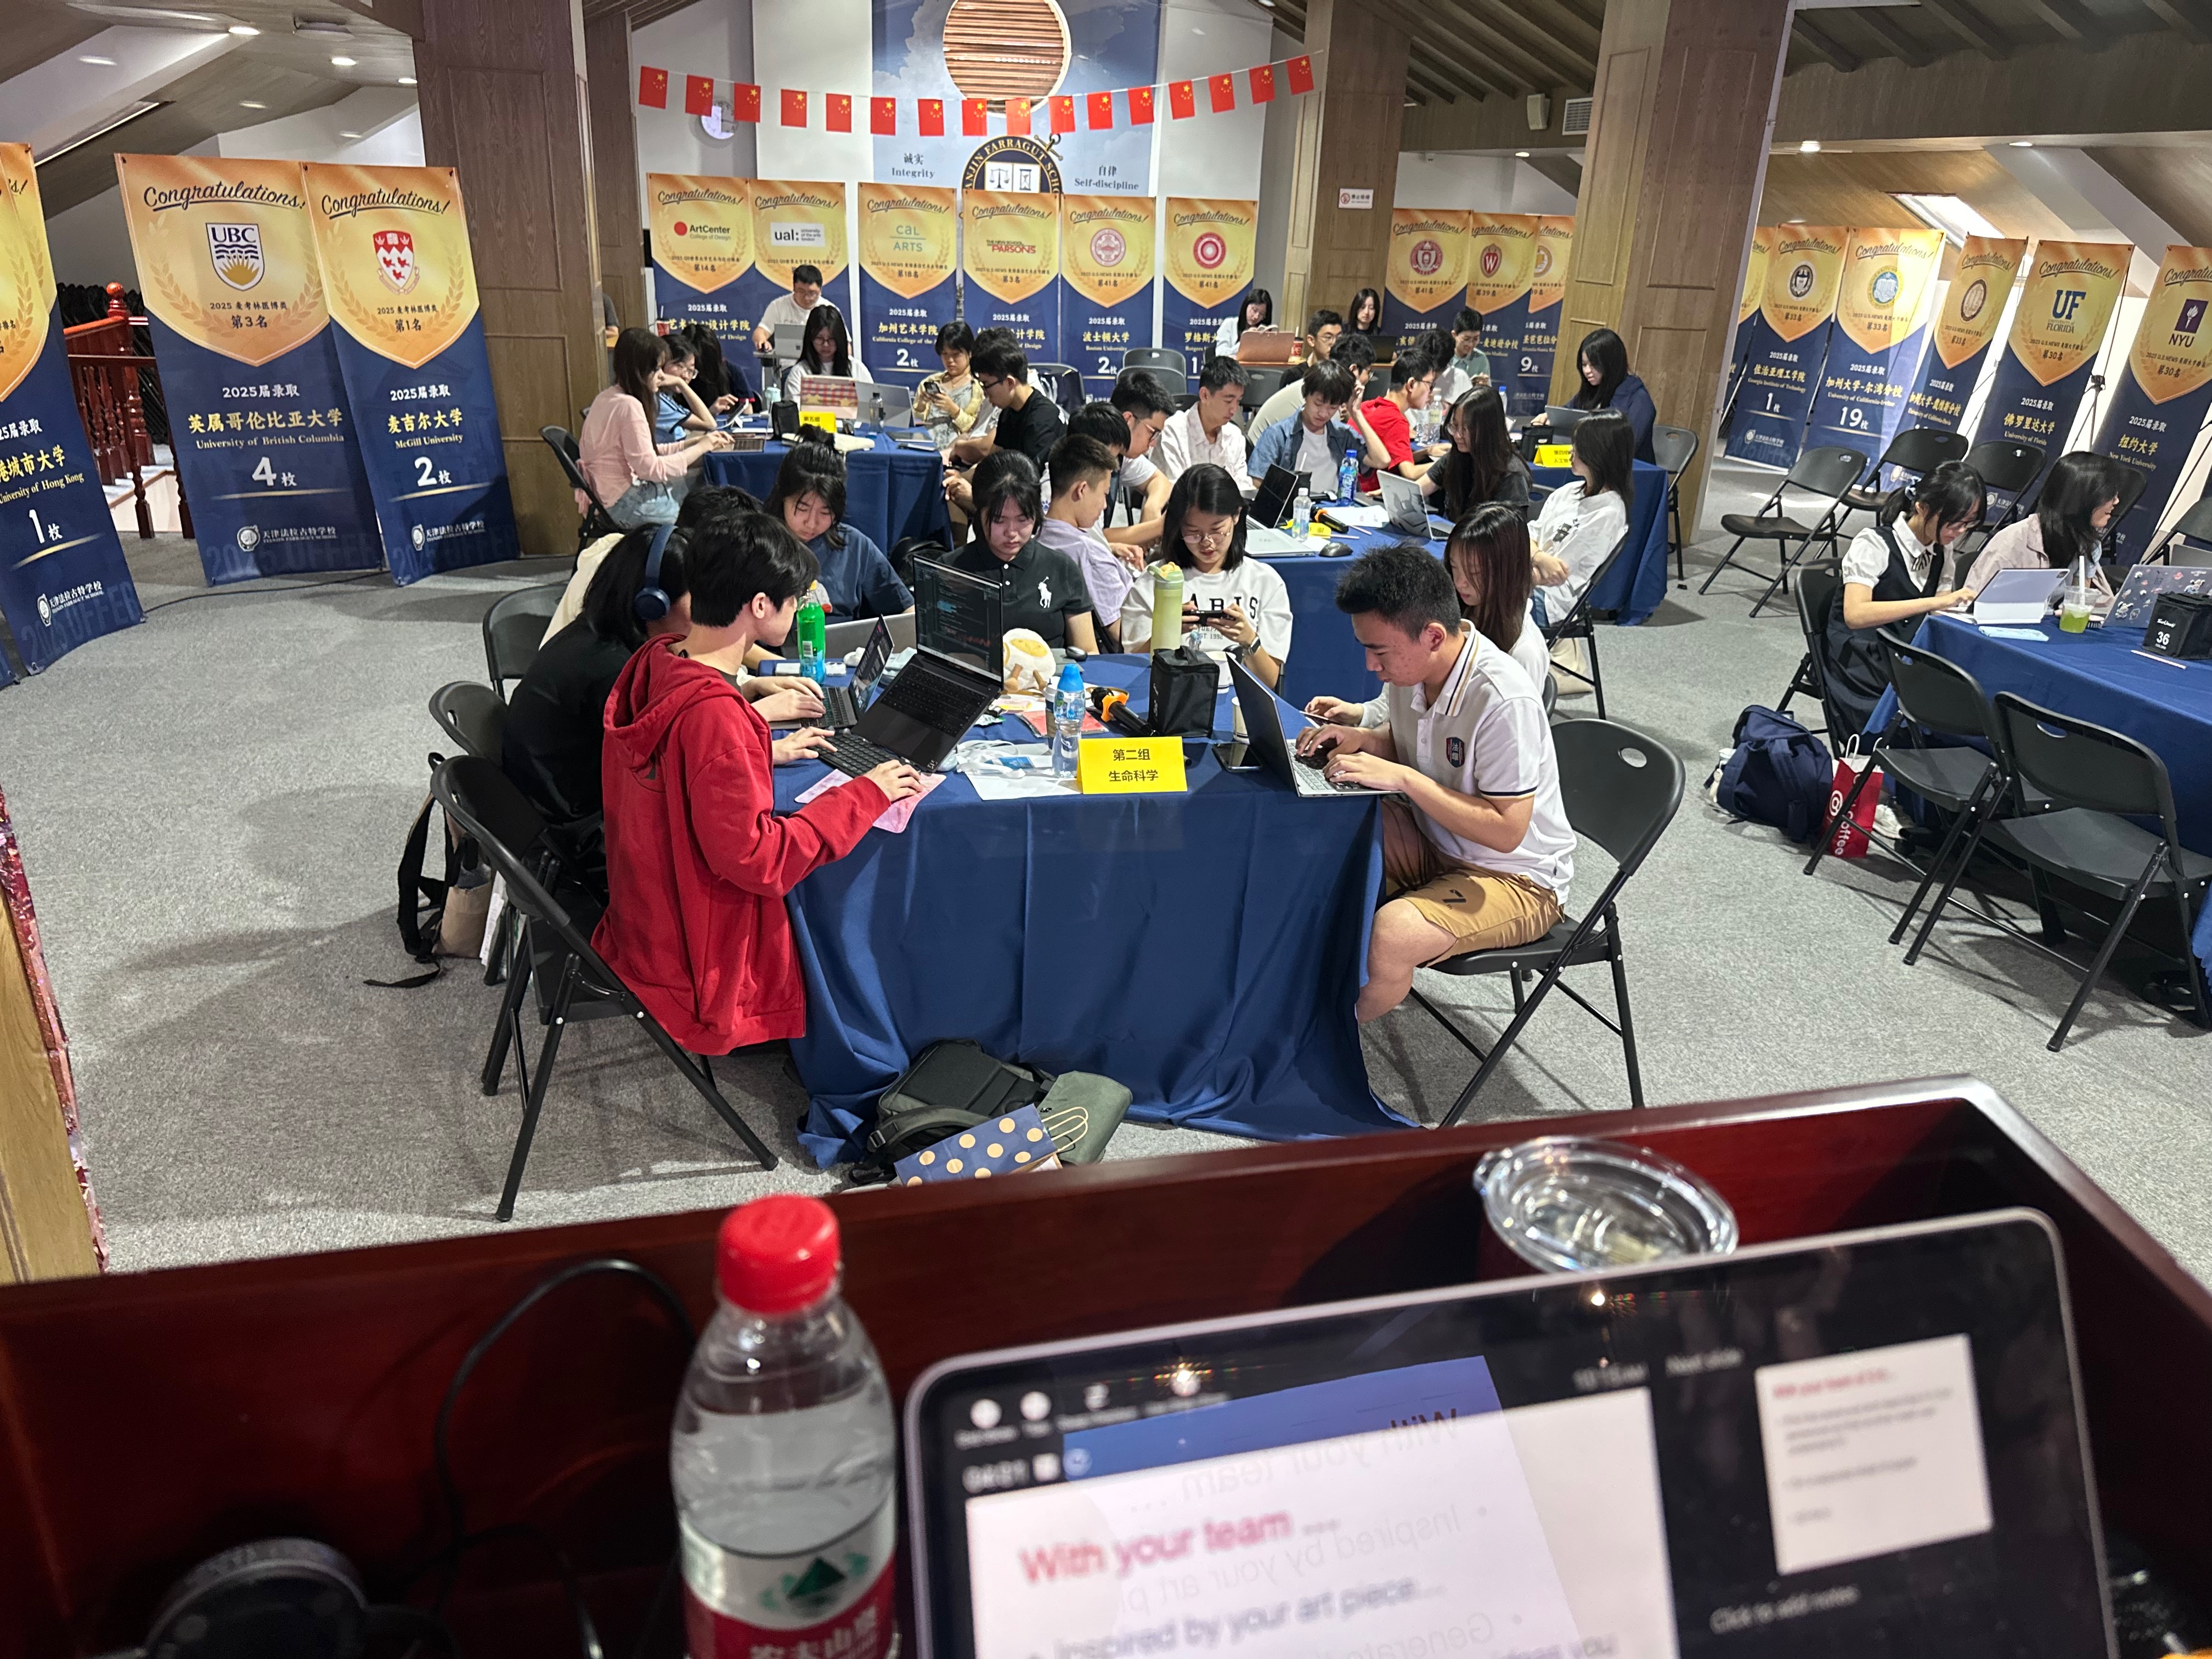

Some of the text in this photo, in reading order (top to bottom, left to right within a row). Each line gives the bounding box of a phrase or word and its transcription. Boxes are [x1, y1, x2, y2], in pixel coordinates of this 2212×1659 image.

[984, 137, 1047, 162] FARRAGUT
[891, 167, 935, 179] Integrity
[1098, 166, 1118, 177] 自律
[1074, 177, 1140, 191] Self-discipline
[144, 180, 306, 211] Congratulations!
[321, 187, 451, 217] Congratulations!
[658, 188, 744, 206] Congratulations!
[755, 192, 839, 211] Congratulations!
[867, 198, 950, 215] Congratulations!
[972, 202, 1052, 219] Congratulations!
[1070, 206, 1147, 224] Congratulations!
[1174, 210, 1250, 226] Congratulations!
[211, 227, 257, 243] UBC
[689, 224, 731, 234] ArtCenter
[774, 229, 799, 242] ual:
[1393, 220, 1466, 235] Congratulations!
[893, 241, 923, 252] ARTS
[991, 244, 1036, 254] PARSONS
[1778, 237, 1842, 256] Congratulations!
[1855, 242, 1934, 259] Congratulations!
[694, 263, 716, 273] 第14名
[1485, 255, 1498, 272] W
[1961, 251, 2016, 272] Congratulations!
[2039, 258, 2120, 280] Congratulations!
[897, 270, 919, 279] 第18名
[1002, 275, 1020, 284] 第3名
[210, 302, 232, 310] 2025
[377, 307, 394, 315] 2025
[687, 303, 728, 313] 2025届录取
[2052, 289, 2086, 320] UF
[889, 308, 928, 318] 2025届录取
[992, 313, 1030, 323] 2025届录取
[231, 314, 268, 329] 第3名
[395, 318, 422, 333] 第1名
[878, 321, 939, 336] 加州艺术学院
[1088, 317, 1126, 326] 2025届录取
[1867, 321, 1888, 332] 第33名
[2046, 323, 2075, 334] FLORIDA
[1082, 331, 1130, 343] 波士顿大学
[2168, 333, 2195, 348] NYU
[896, 348, 919, 368] 2 枚
[1769, 351, 1799, 363] 2025届录取
[2042, 349, 2063, 361] 第30名
[1098, 356, 1110, 374] 2
[1192, 357, 1198, 374] 1
[1521, 357, 1532, 372] 9
[1850, 363, 1886, 376] 2025届录取
[2157, 364, 2181, 378] 第30名
[1753, 364, 1806, 383] 佐治亚理工学院
[222, 383, 300, 398] 2025届录取
[390, 383, 451, 402] 2025届录取
[1825, 376, 1903, 398] 加州大学-尔湾分校
[1766, 392, 1781, 413] 1 枚
[2021, 397, 2054, 411] 2025届录取
[188, 407, 343, 434] 英属哥伦比亚大学
[387, 407, 463, 435] 麦吉尔大学
[1839, 406, 1869, 430] 19 枚
[2004, 413, 2055, 435] 佛罗里达大学
[2129, 415, 2167, 433] 2025届录取
[196, 433, 345, 449] University of British Columbia
[394, 433, 464, 450] McGill University
[2118, 434, 2158, 456] 纽约大学
[252, 456, 297, 487] 4 枚
[414, 456, 452, 487] 2 枚
[31, 482, 39, 493] of
[41, 478, 65, 489] Hong
[64, 472, 84, 483] Kong
[29, 509, 63, 544] 1 枚
[50, 580, 103, 608] 天津法拉古特学校
[2156, 631, 2170, 646] 36
[1112, 748, 1152, 761] 第二组
[1108, 769, 1159, 783] 生命科学
[1018, 1510, 1293, 1584] With your team
[1184, 1615, 1223, 1646] by
[1227, 1604, 1291, 1641] your
